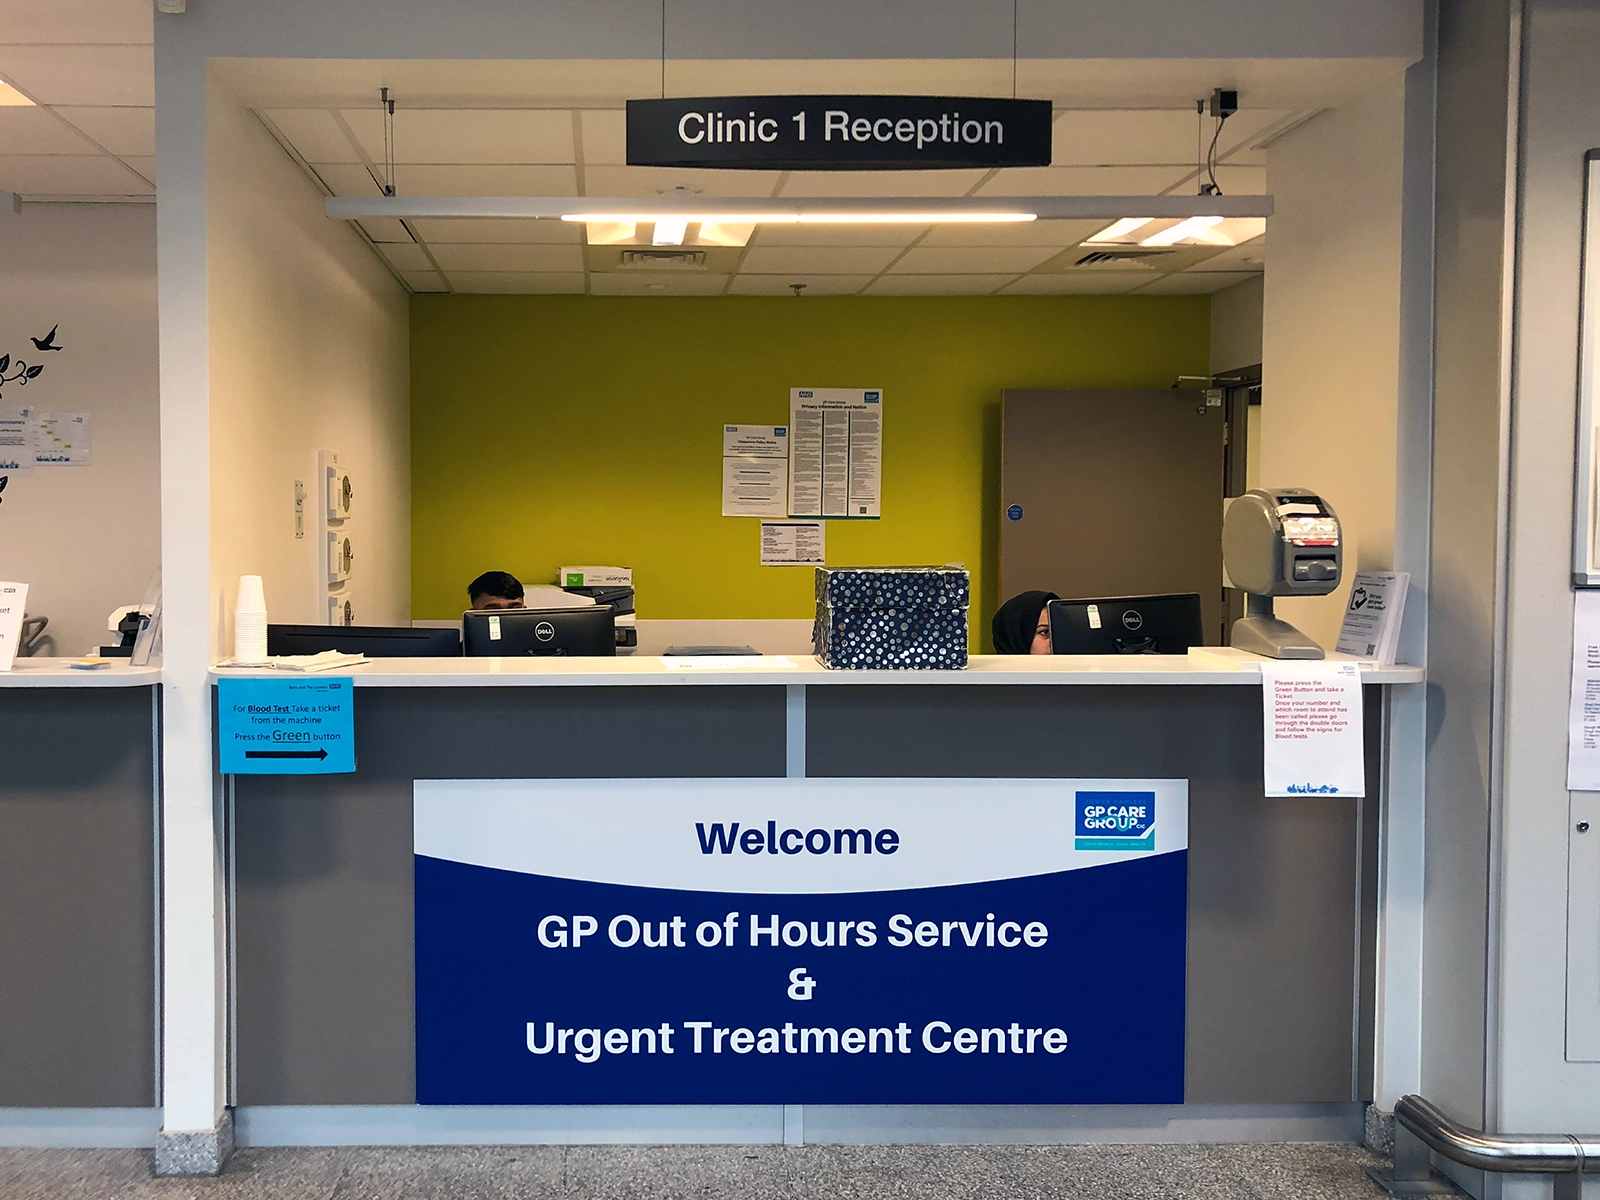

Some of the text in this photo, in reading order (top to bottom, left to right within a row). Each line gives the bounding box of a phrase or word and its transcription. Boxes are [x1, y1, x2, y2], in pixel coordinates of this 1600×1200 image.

[678, 110, 1003, 149] Clinic 1 Reception
[272, 729, 311, 741] Green
[1084, 806, 1146, 818] GP CARE
[1084, 817, 1138, 829] GROUP
[695, 820, 900, 855] Welcome
[537, 911, 1049, 948] GP Out of Hours Service
[787, 967, 817, 1001] &
[526, 1020, 1068, 1063] Urgent Treatment Centre
